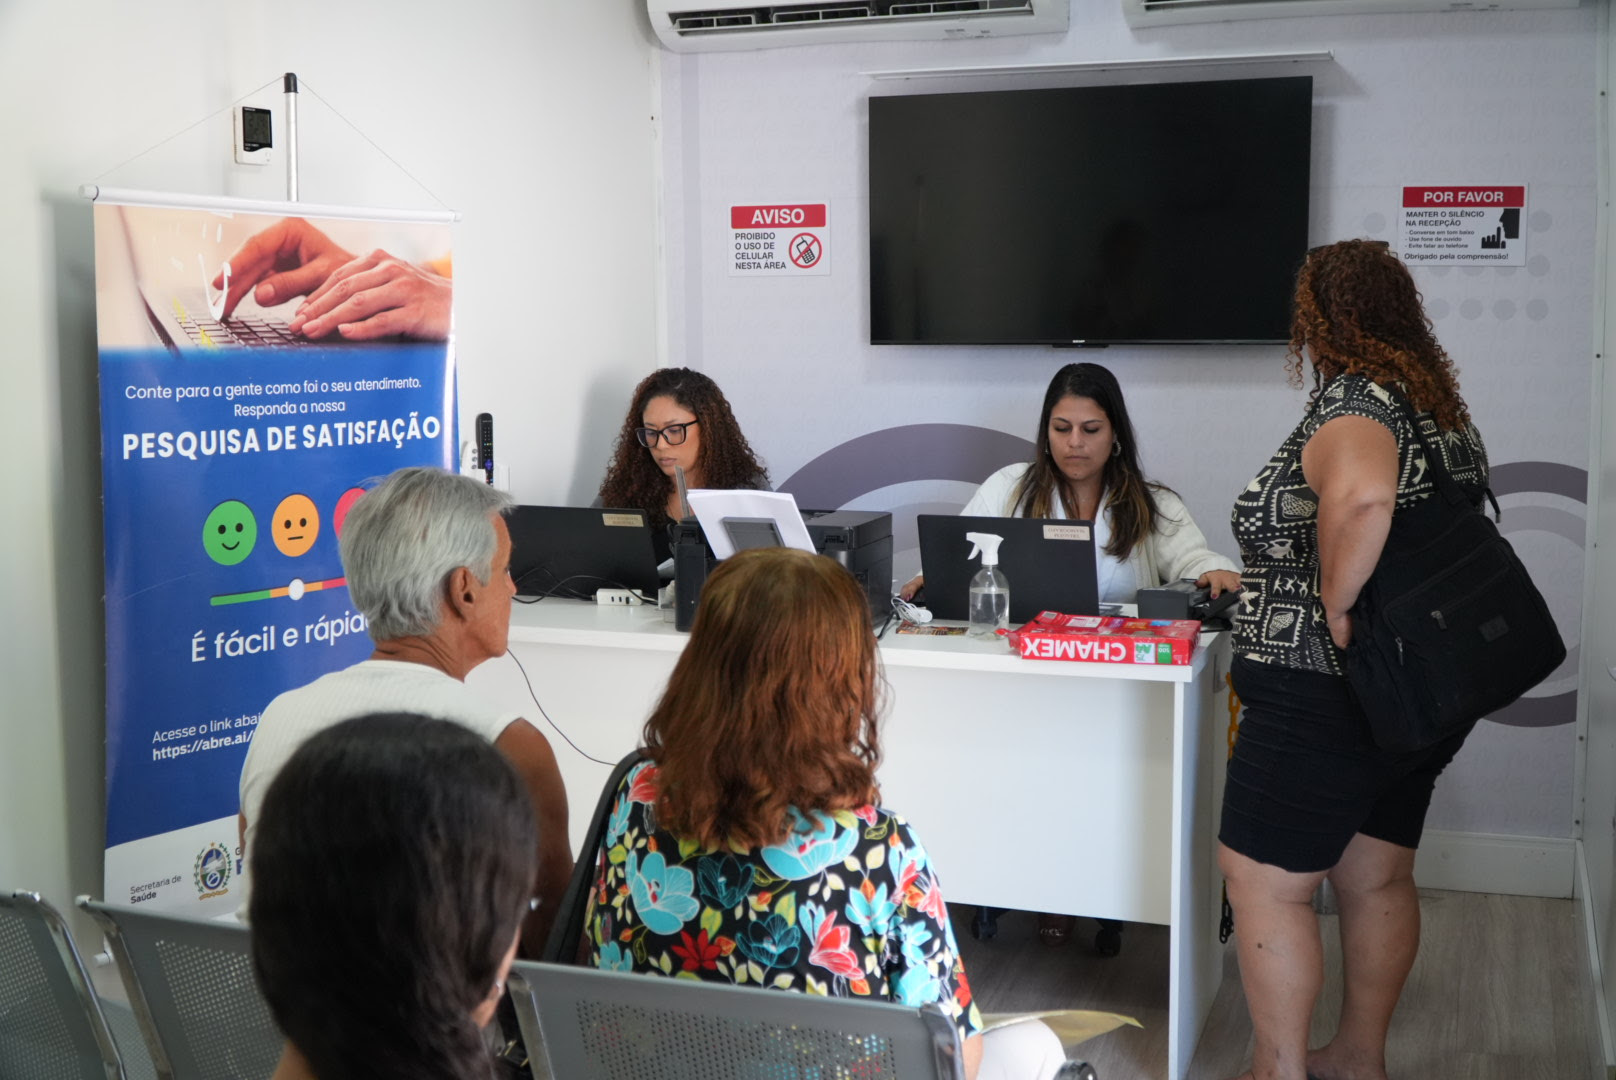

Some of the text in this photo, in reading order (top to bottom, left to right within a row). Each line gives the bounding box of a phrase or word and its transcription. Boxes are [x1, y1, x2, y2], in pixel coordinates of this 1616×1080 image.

[1424, 191, 1504, 202] POR FAVOR
[751, 208, 804, 224] AVISO
[1419, 219, 1461, 227] RECEPÇÃO
[735, 232, 775, 240] PROIBIDO
[764, 260, 786, 269] ÁREA
[125, 377, 421, 402] Conte para a gente como foi o seu atendimento.
[234, 401, 346, 420] Responda a nossa
[123, 411, 440, 460] PESQUISA DE SATISFAÇÃO
[192, 610, 370, 662] É fácil e rápid
[1024, 637, 1126, 662] CHAMEX
[152, 726, 196, 744] Acesse
[199, 724, 207, 734] o
[210, 718, 232, 732] link
[153, 730, 255, 761] https://abre.ai/
[130, 875, 181, 894] Secretaria de
[130, 891, 156, 904] Saúde
